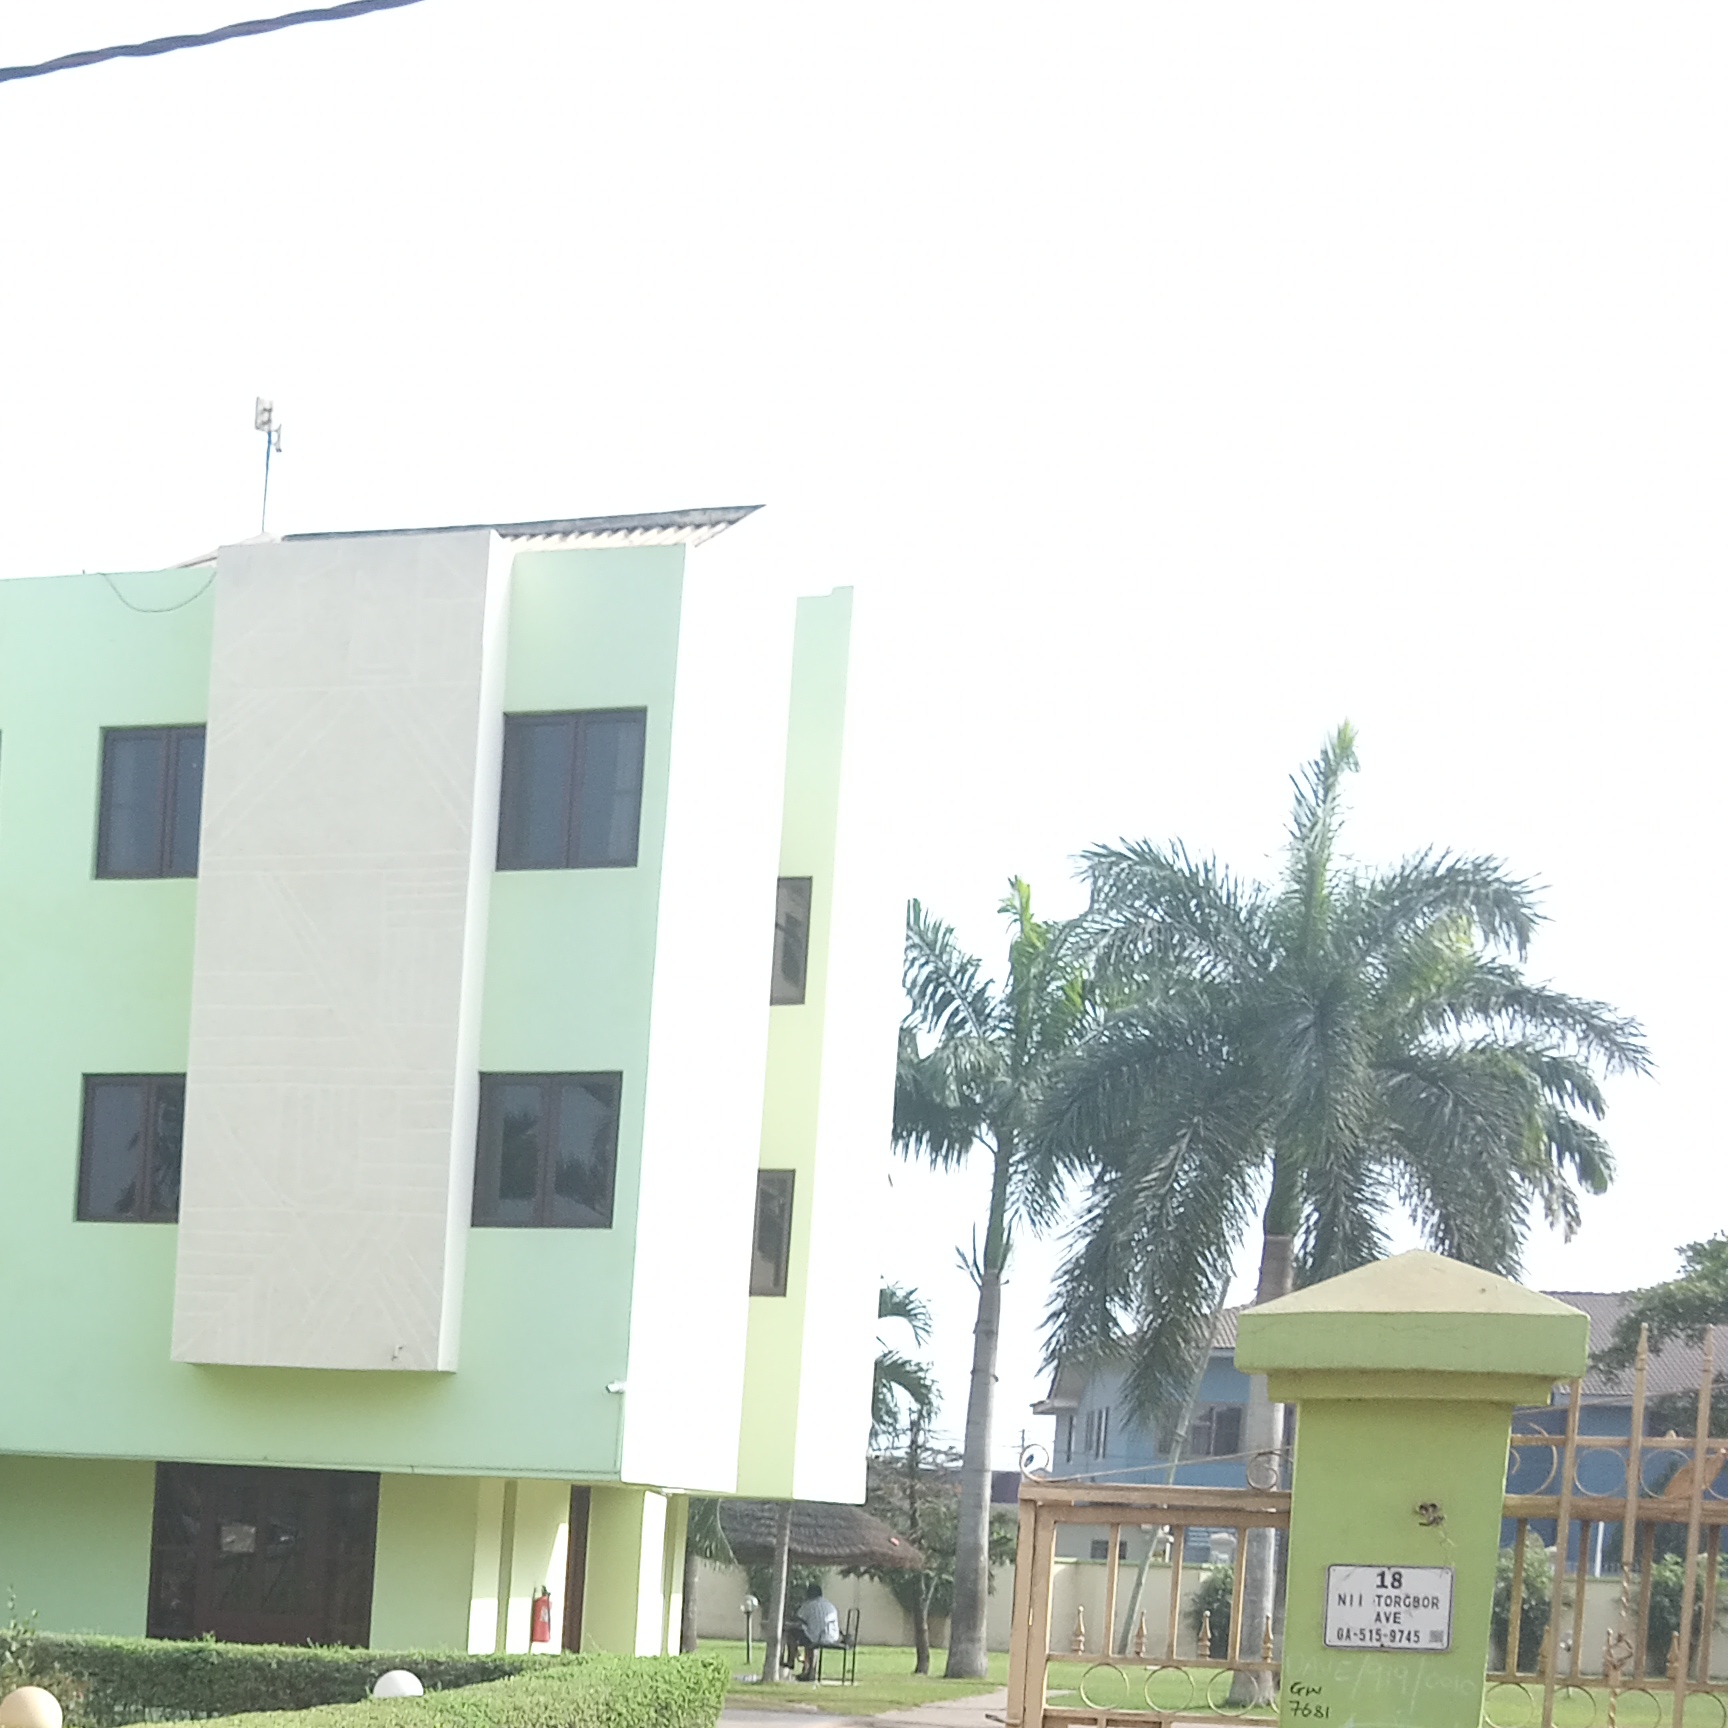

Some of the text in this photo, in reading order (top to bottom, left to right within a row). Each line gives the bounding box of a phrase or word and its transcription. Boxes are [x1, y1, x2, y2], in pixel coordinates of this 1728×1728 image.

[1375, 1570, 1403, 1590] 18
[1337, 1592, 1440, 1610] NII TORGBOR
[1374, 1610, 1402, 1625] AVE
[1288, 1700, 1330, 1719] 7681
